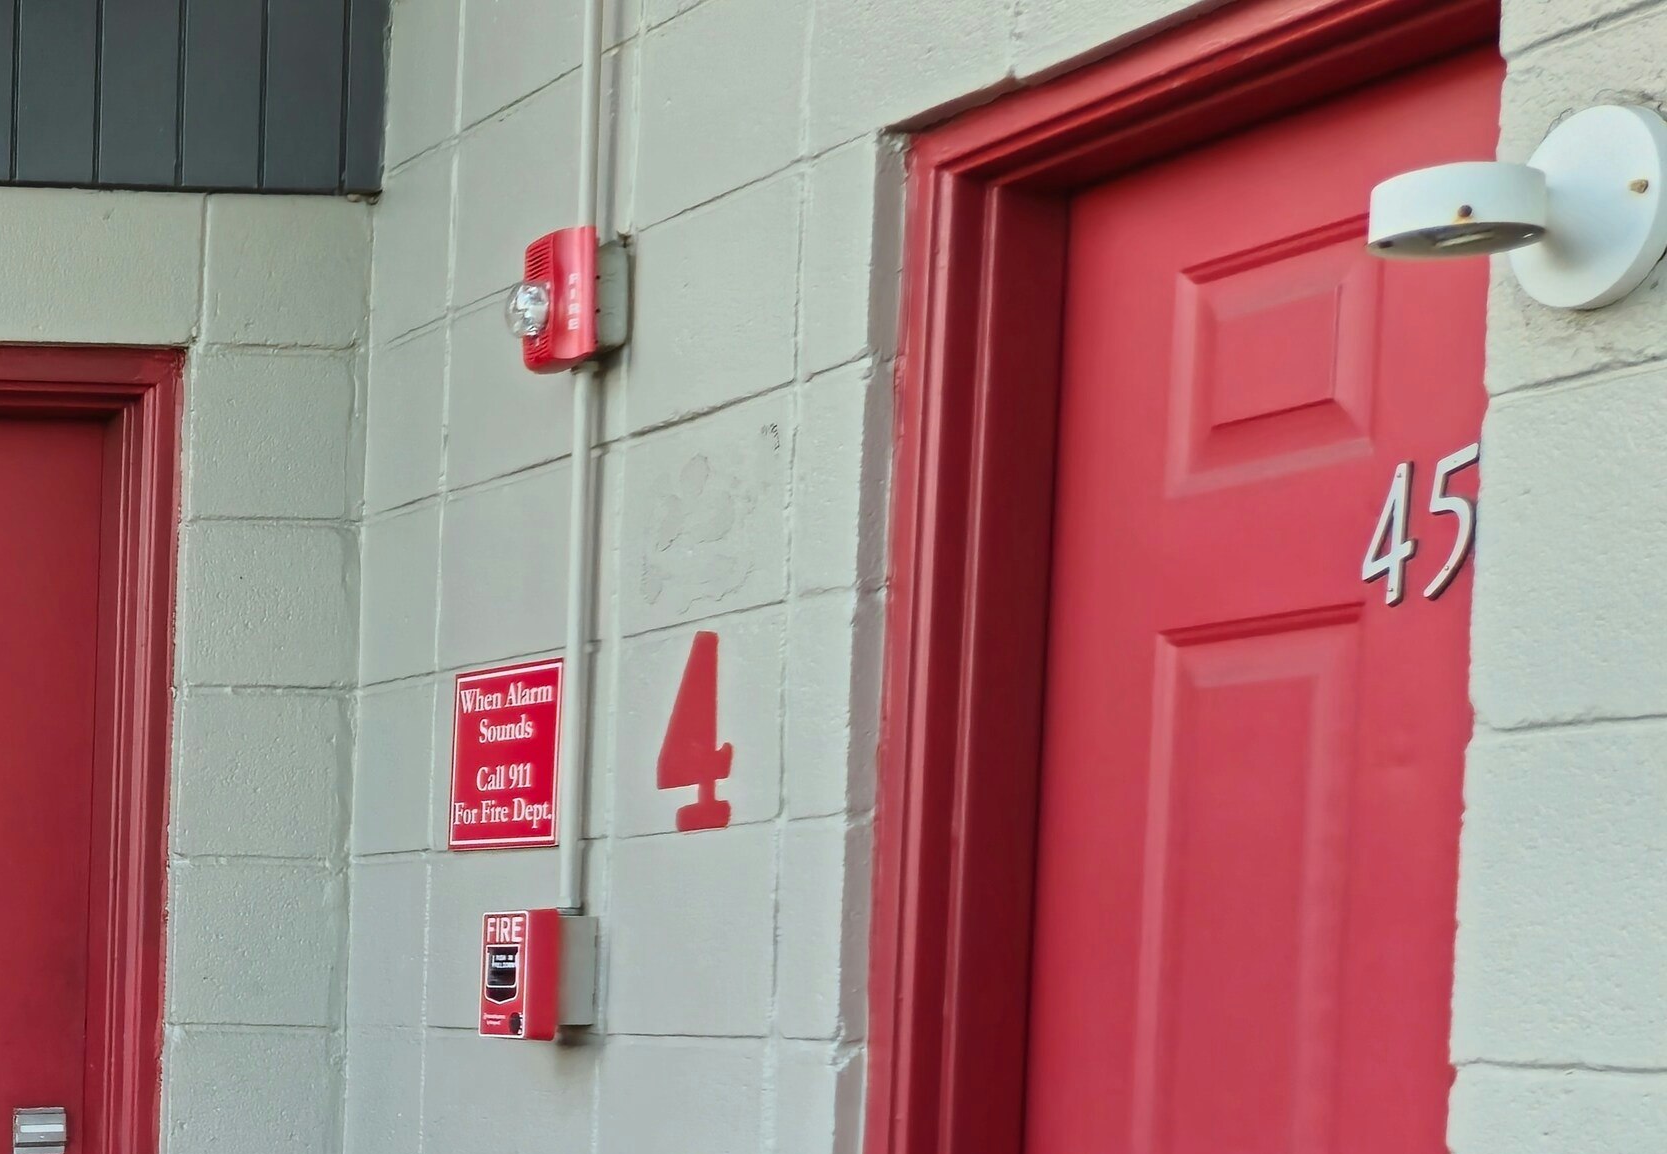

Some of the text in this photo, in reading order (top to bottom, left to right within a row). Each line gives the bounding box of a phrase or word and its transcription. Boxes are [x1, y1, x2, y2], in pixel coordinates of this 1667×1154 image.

[1362, 442, 1480, 607] 45
[460, 682, 553, 714] When Alarm
[478, 714, 534, 744] Sounds
[656, 630, 734, 832] 4
[476, 763, 532, 792] Call 911
[453, 797, 552, 829] For Fire Dept.
[486, 916, 524, 943] FIRE
